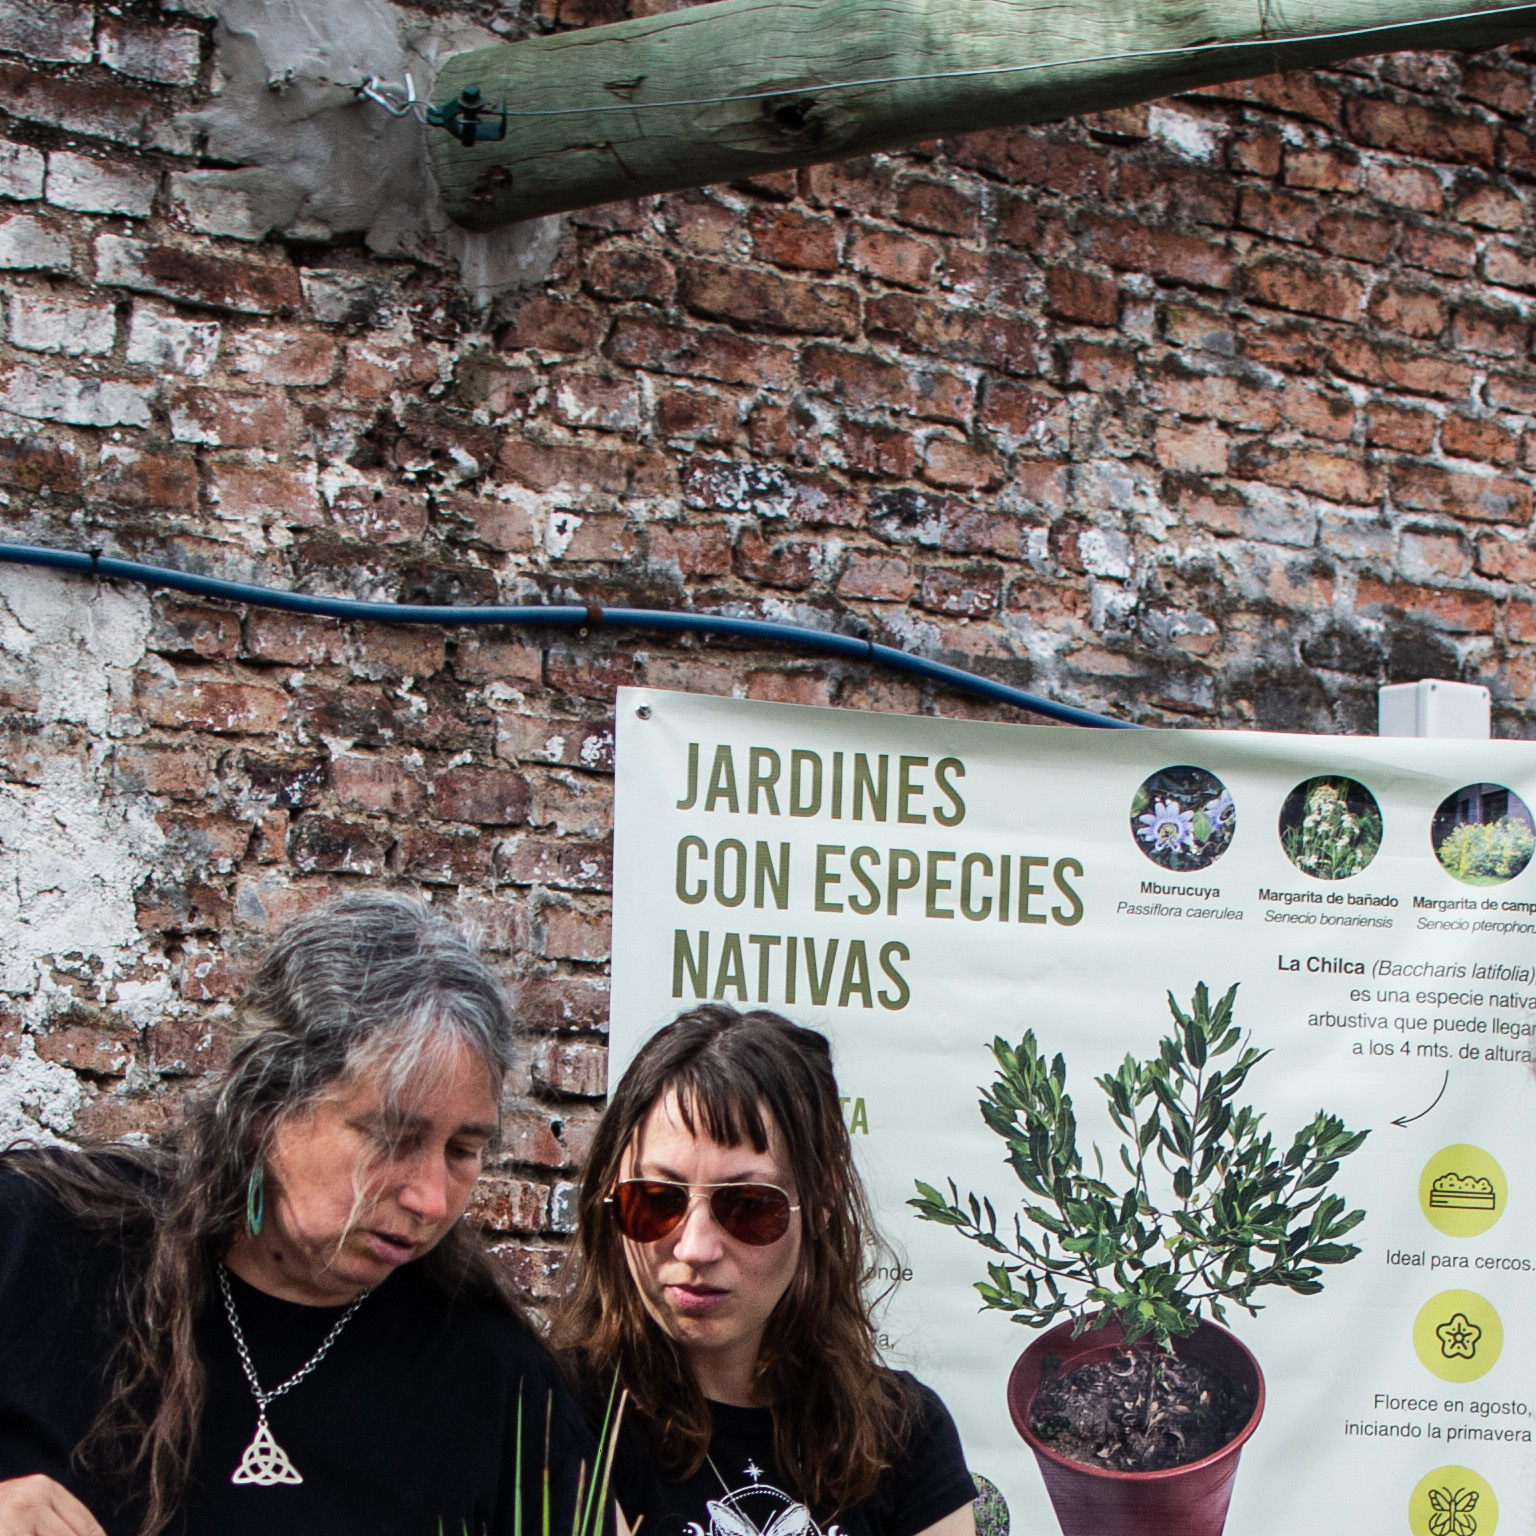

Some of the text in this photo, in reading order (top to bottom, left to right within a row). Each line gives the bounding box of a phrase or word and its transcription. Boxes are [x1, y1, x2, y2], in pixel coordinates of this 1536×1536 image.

[676, 743, 966, 827] JARDINES
[675, 835, 1084, 926] CON ESPECIES
[1140, 881, 1220, 900] Mburucuya
[1258, 888, 1399, 908] Margarita de bañado
[1413, 896, 1477, 913] Margarita
[1481, 898, 1498, 910] de
[1116, 901, 1244, 921] Passiflora caerulea
[1264, 910, 1393, 929] Senecio bonariensis
[1416, 917, 1469, 931] Senecio
[671, 929, 911, 1011] NATIVAS
[1278, 955, 1300, 972] La
[1306, 956, 1365, 975] Chilca
[1371, 959, 1466, 980] (Baccharis
[1350, 988, 1371, 1002] es
[1377, 989, 1410, 1003] una
[1416, 989, 1484, 1007] especie
[1308, 1011, 1388, 1029] arbustiva
[1394, 1016, 1427, 1033] que
[1433, 1015, 1487, 1034] puede
[1352, 1043, 1363, 1055] a
[1369, 1040, 1394, 1056] los
[1400, 1041, 1411, 1055] 4
[1417, 1043, 1453, 1058] mts.
[1459, 1043, 1479, 1059] de
[1386, 1249, 1536, 1271] Ideal para cercos.
[1374, 1394, 1532, 1418] Florece en agosto,
[1344, 1420, 1532, 1443] iniciando la primavera
